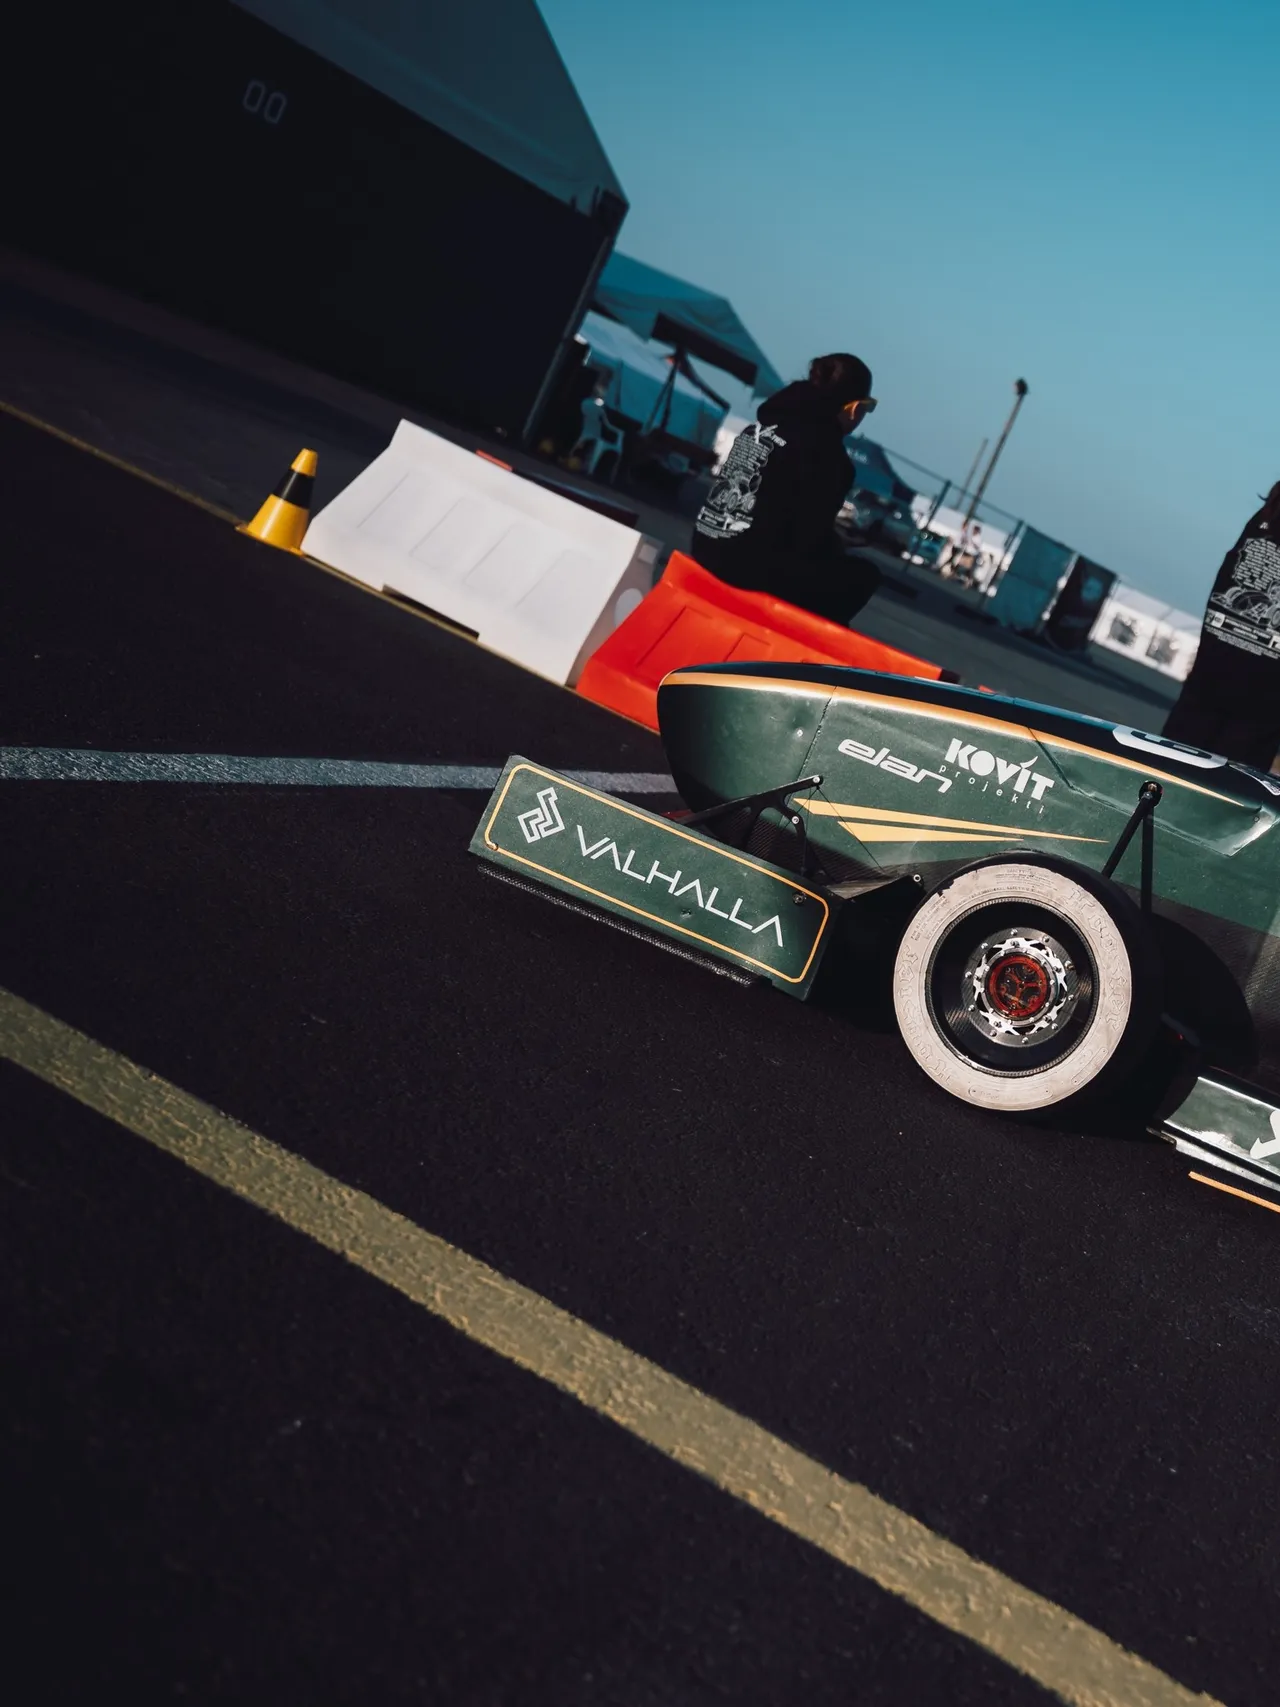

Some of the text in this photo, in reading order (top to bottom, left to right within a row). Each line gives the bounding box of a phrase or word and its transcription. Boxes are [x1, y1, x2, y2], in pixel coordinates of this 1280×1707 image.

[837, 738, 953, 793] elan
[938, 763, 1044, 814] projekti
[576, 824, 784, 948] VALHALLA
